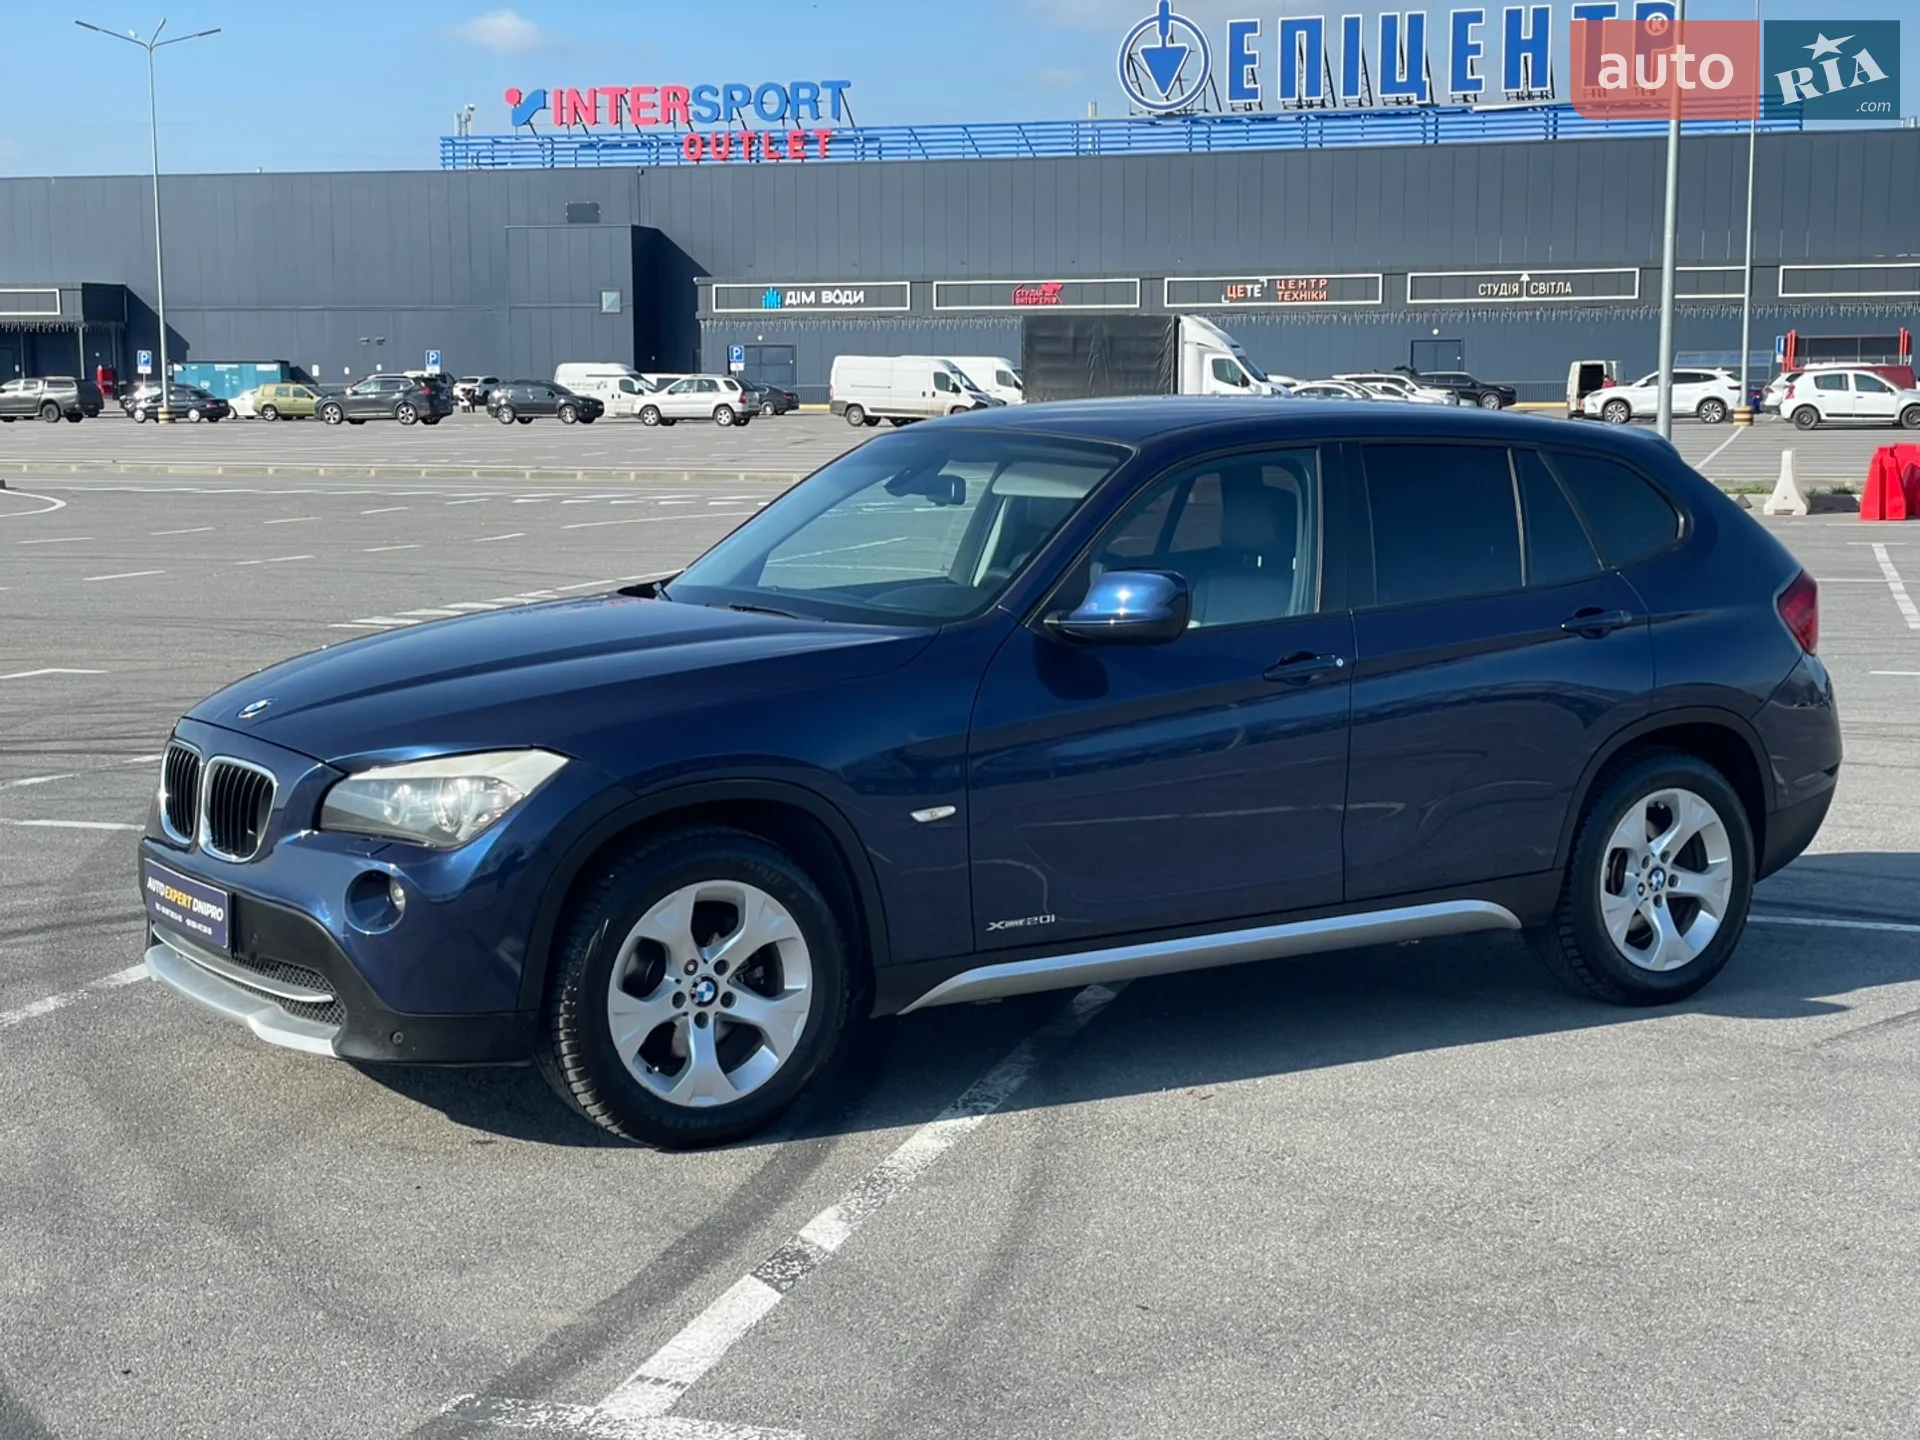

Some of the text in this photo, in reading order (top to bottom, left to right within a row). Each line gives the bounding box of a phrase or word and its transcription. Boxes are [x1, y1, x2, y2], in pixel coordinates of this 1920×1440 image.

[552, 79, 852, 126] INTERSPORT
[683, 129, 832, 161] OUTLET
[1227, 284, 1262, 299] ЦЕТЕ
[1276, 278, 1328, 290] ЦЕНТР
[1478, 281, 1572, 296] СТУДІЯ СВІТЛА
[785, 288, 865, 306] ДІМ ВОДИ
[1277, 290, 1327, 301] ТЕХНІКИ
[733, 347, 741, 360] P
[192, 898, 224, 922] DNIPRO
